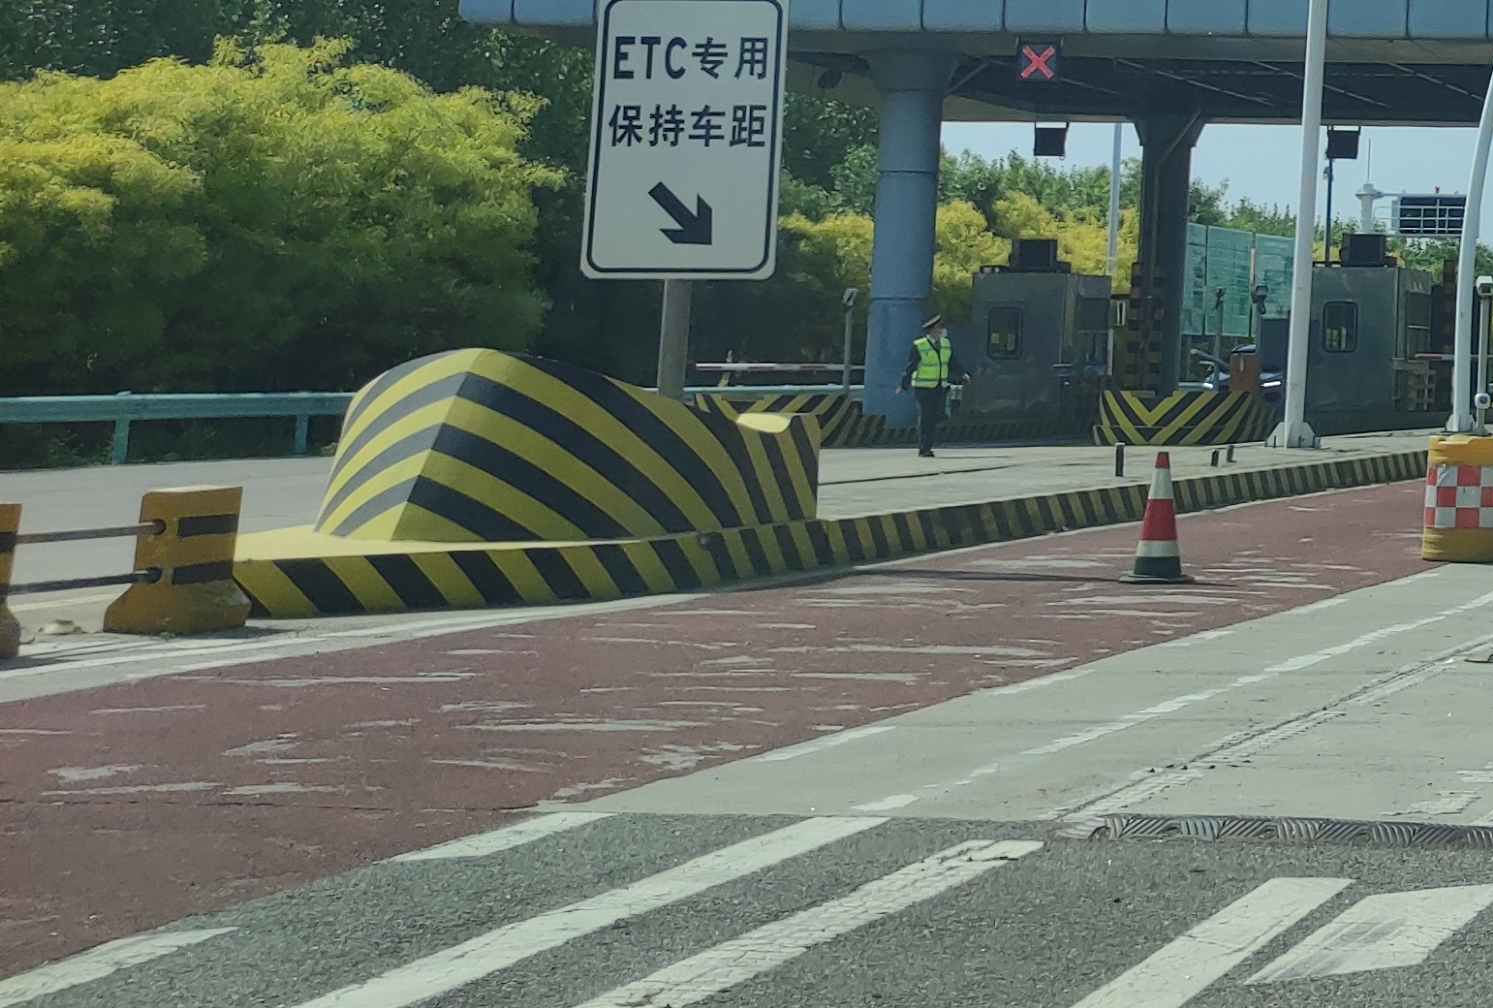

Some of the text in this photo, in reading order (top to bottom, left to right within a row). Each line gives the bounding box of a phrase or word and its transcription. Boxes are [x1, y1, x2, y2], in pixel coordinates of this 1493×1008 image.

[613, 36, 769, 80] ETC专用
[608, 103, 768, 148] 保持车距
